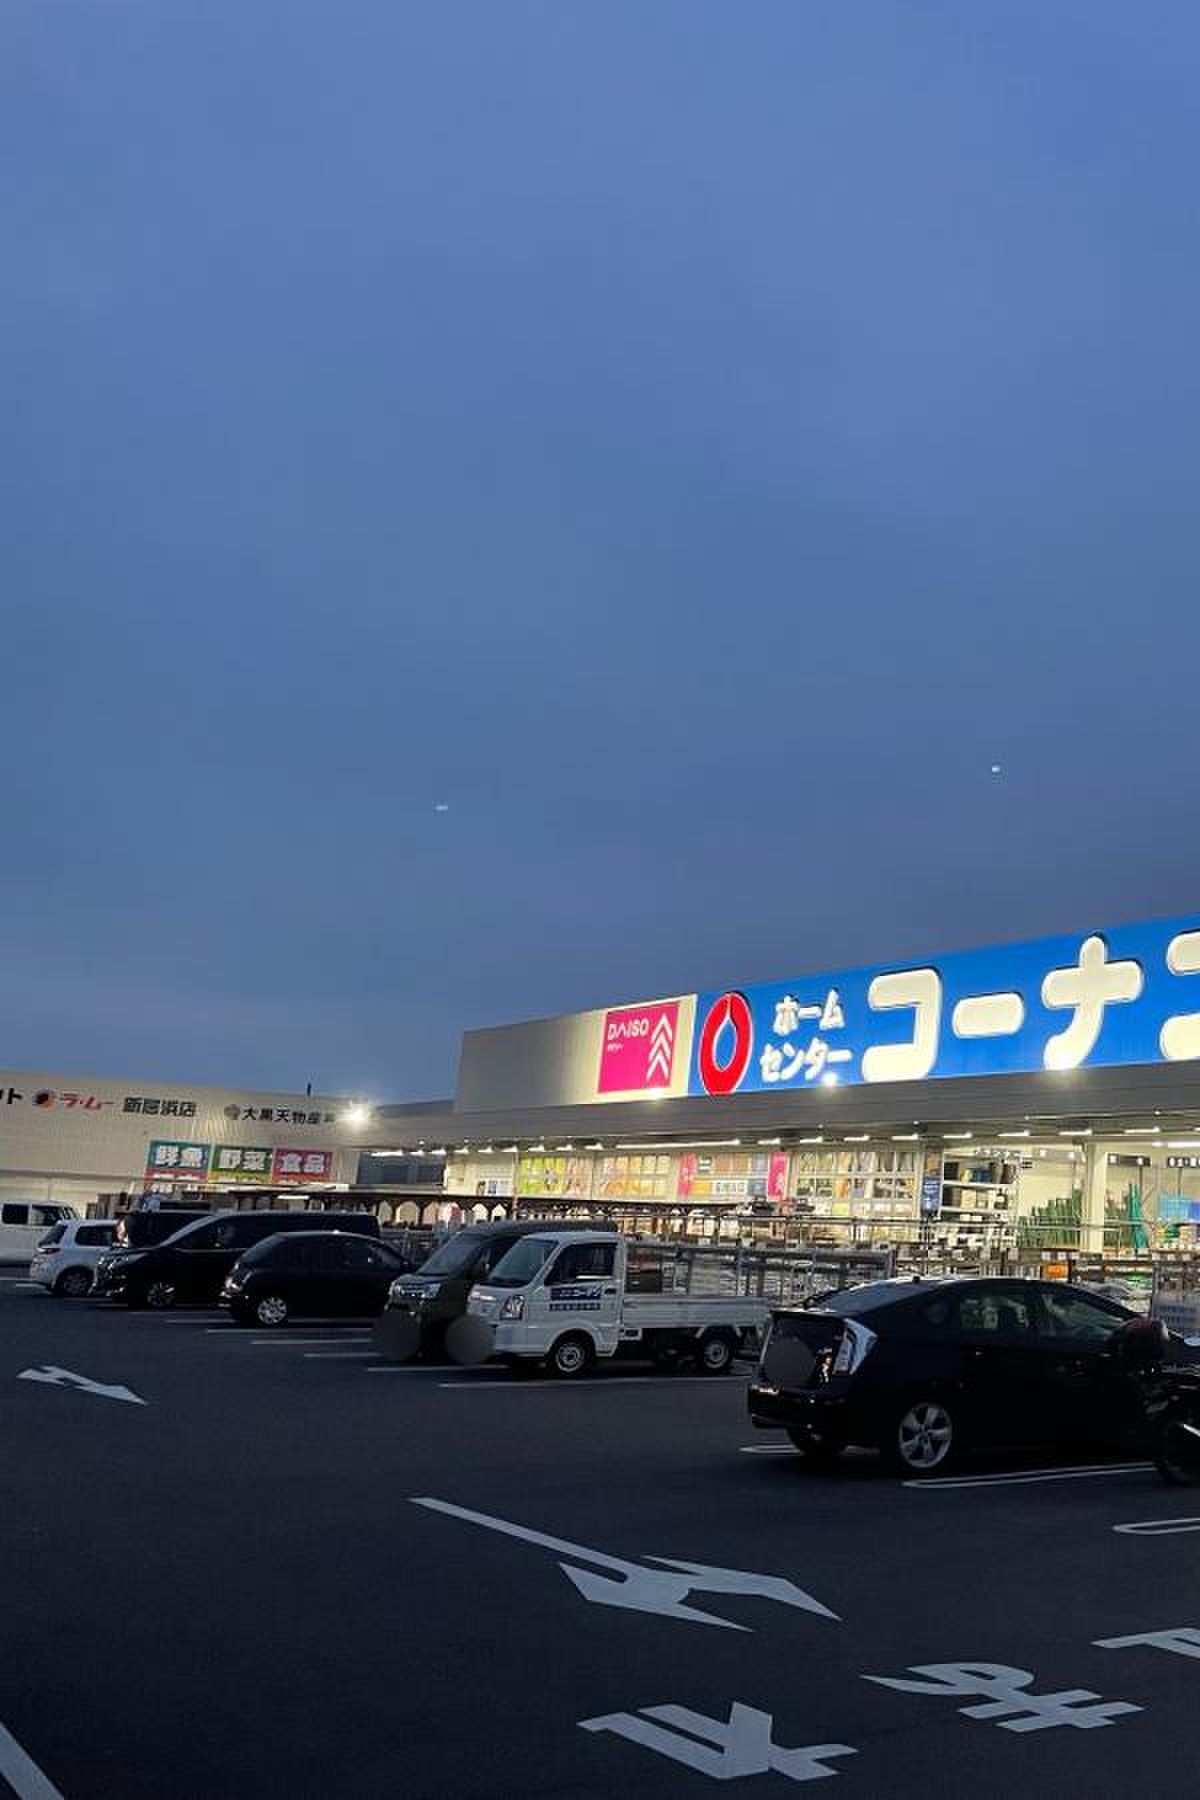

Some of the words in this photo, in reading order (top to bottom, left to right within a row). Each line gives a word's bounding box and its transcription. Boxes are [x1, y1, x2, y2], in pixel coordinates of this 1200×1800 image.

[773, 989, 845, 1035] ホーム
[607, 1018, 649, 1040] DAISO
[760, 1037, 850, 1082] センター
[0, 1087, 23, 1105] ト
[280, 1153, 325, 1173] 食品
